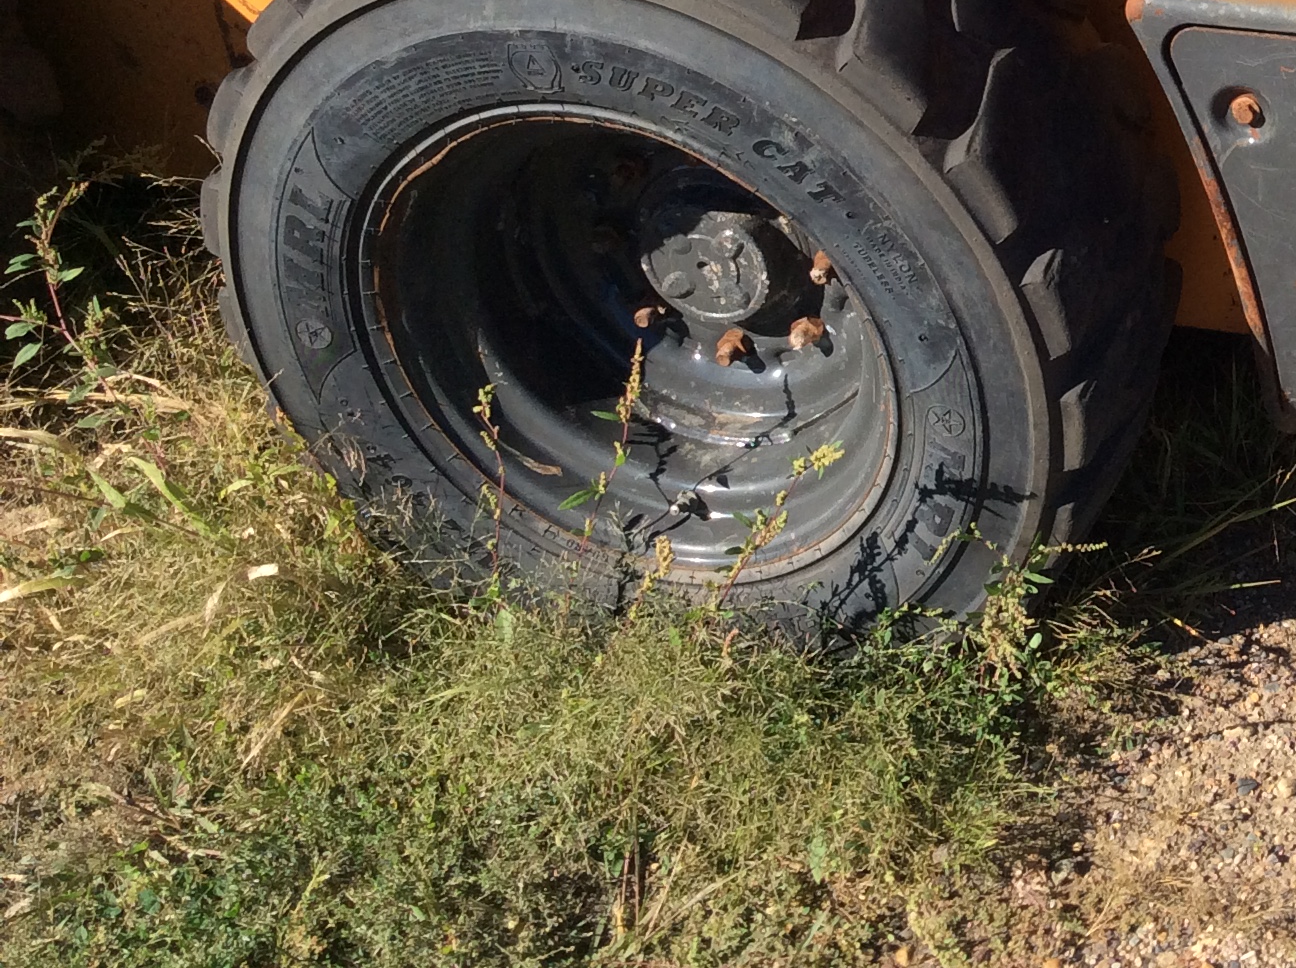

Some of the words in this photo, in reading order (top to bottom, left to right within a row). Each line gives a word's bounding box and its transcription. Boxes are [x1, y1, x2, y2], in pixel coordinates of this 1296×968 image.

[577, 60, 741, 137] SUPER
[751, 138, 847, 204] CAT
[877, 232, 918, 285] NYLON
